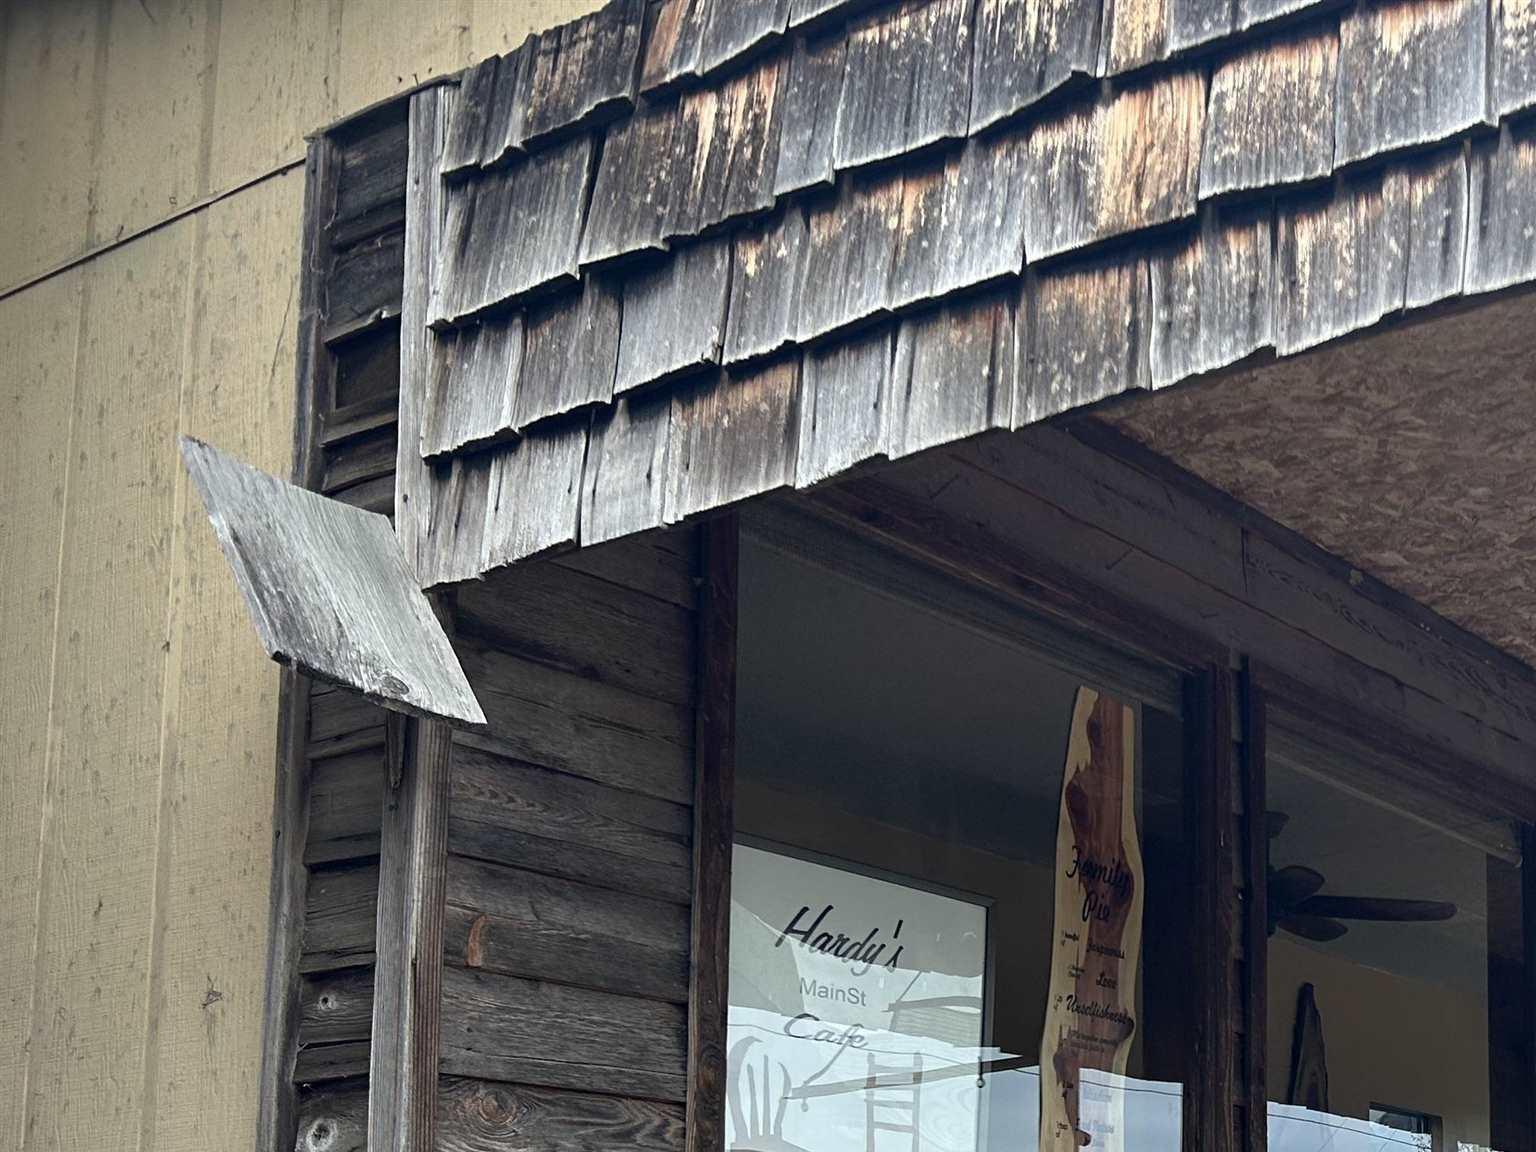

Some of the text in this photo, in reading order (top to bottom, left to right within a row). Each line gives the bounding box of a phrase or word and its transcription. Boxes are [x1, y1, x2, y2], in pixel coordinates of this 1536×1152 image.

[1082, 890, 1110, 922] Pie
[774, 904, 904, 976] Hardy's
[799, 977, 867, 1007] MainSt
